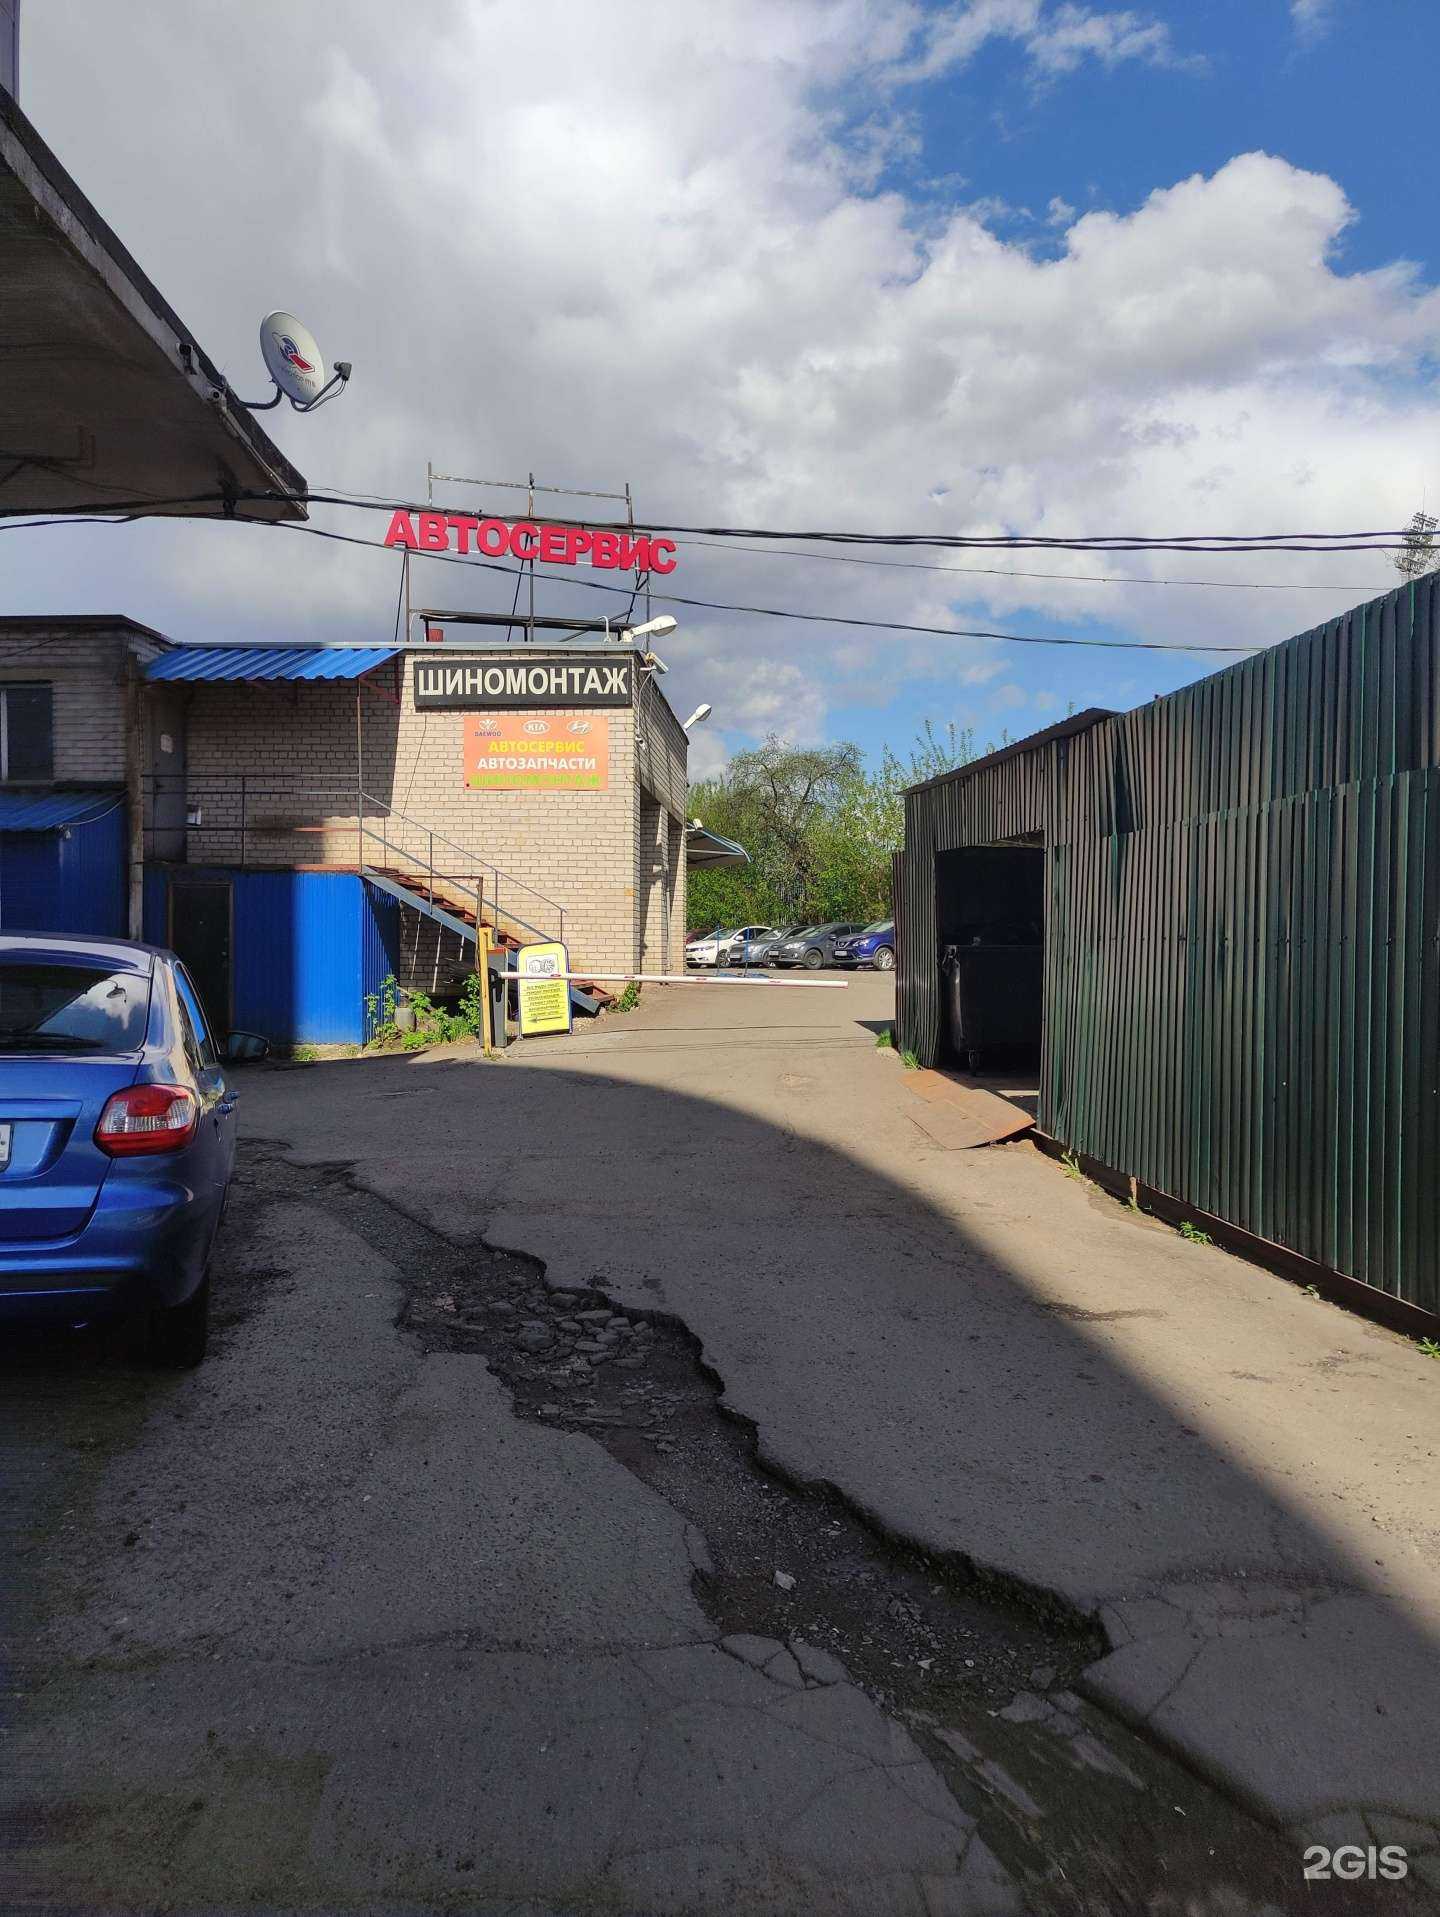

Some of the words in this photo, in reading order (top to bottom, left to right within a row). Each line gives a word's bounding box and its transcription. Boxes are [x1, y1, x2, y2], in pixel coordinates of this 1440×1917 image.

[384, 509, 677, 575] АВТОСЕРВИС
[418, 667, 628, 696] ШИНОМОНТАЖ
[488, 740, 585, 753] АВТОСЕРВИС
[477, 757, 596, 770] АВТОЗАПЧАСТИ
